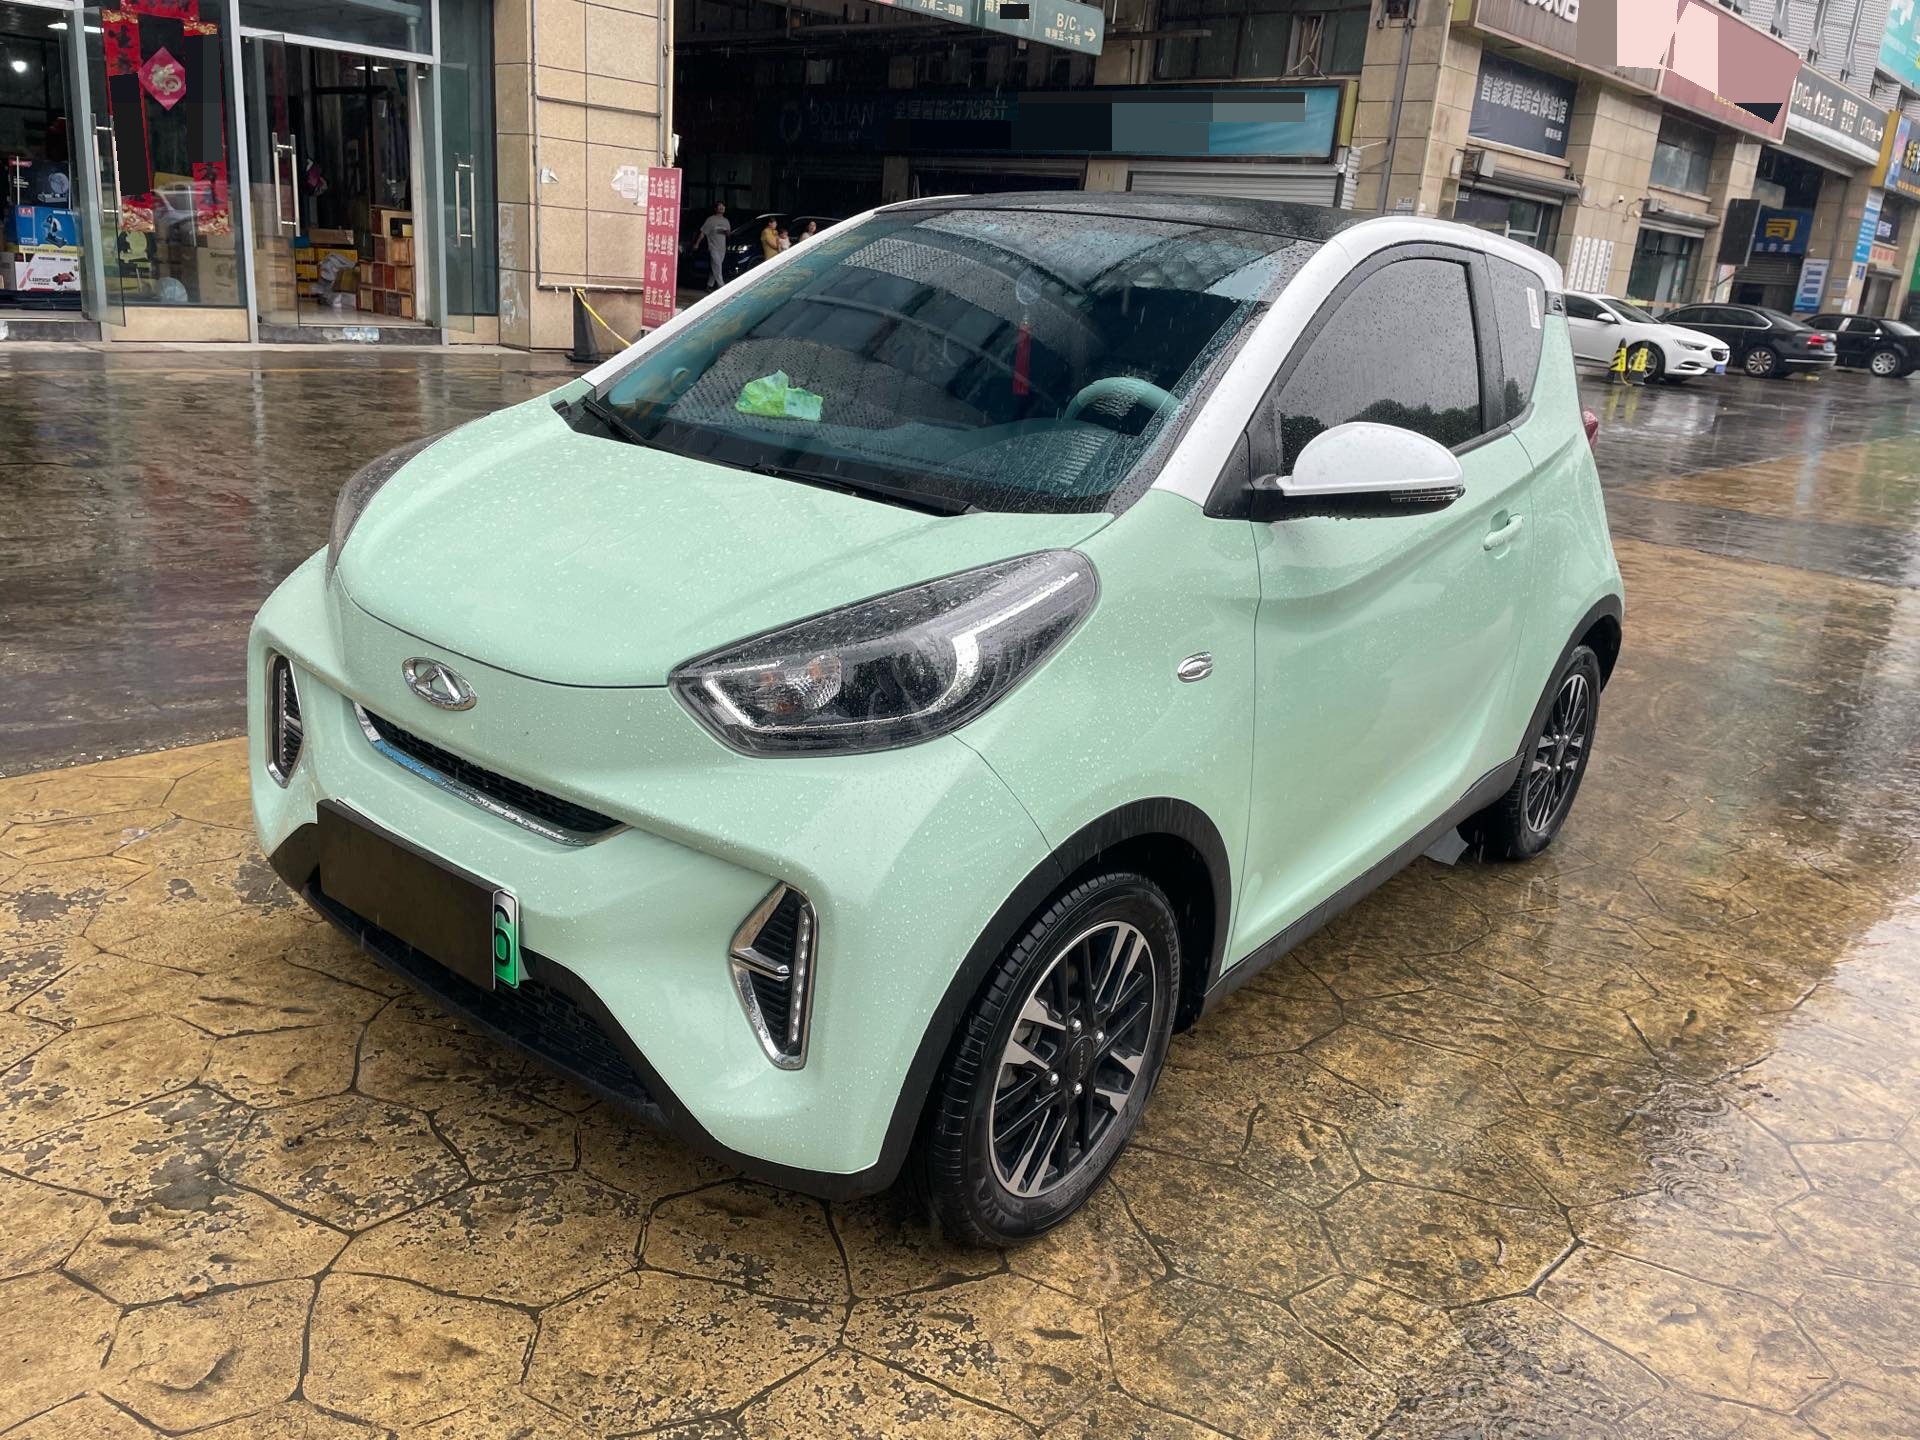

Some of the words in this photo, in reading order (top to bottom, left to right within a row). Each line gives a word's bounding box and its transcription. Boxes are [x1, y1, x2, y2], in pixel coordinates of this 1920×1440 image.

[1481, 74, 1568, 124] 智能家居综合体验馆
[649, 176, 676, 200] 五金电器
[648, 206, 675, 228] 电动工具
